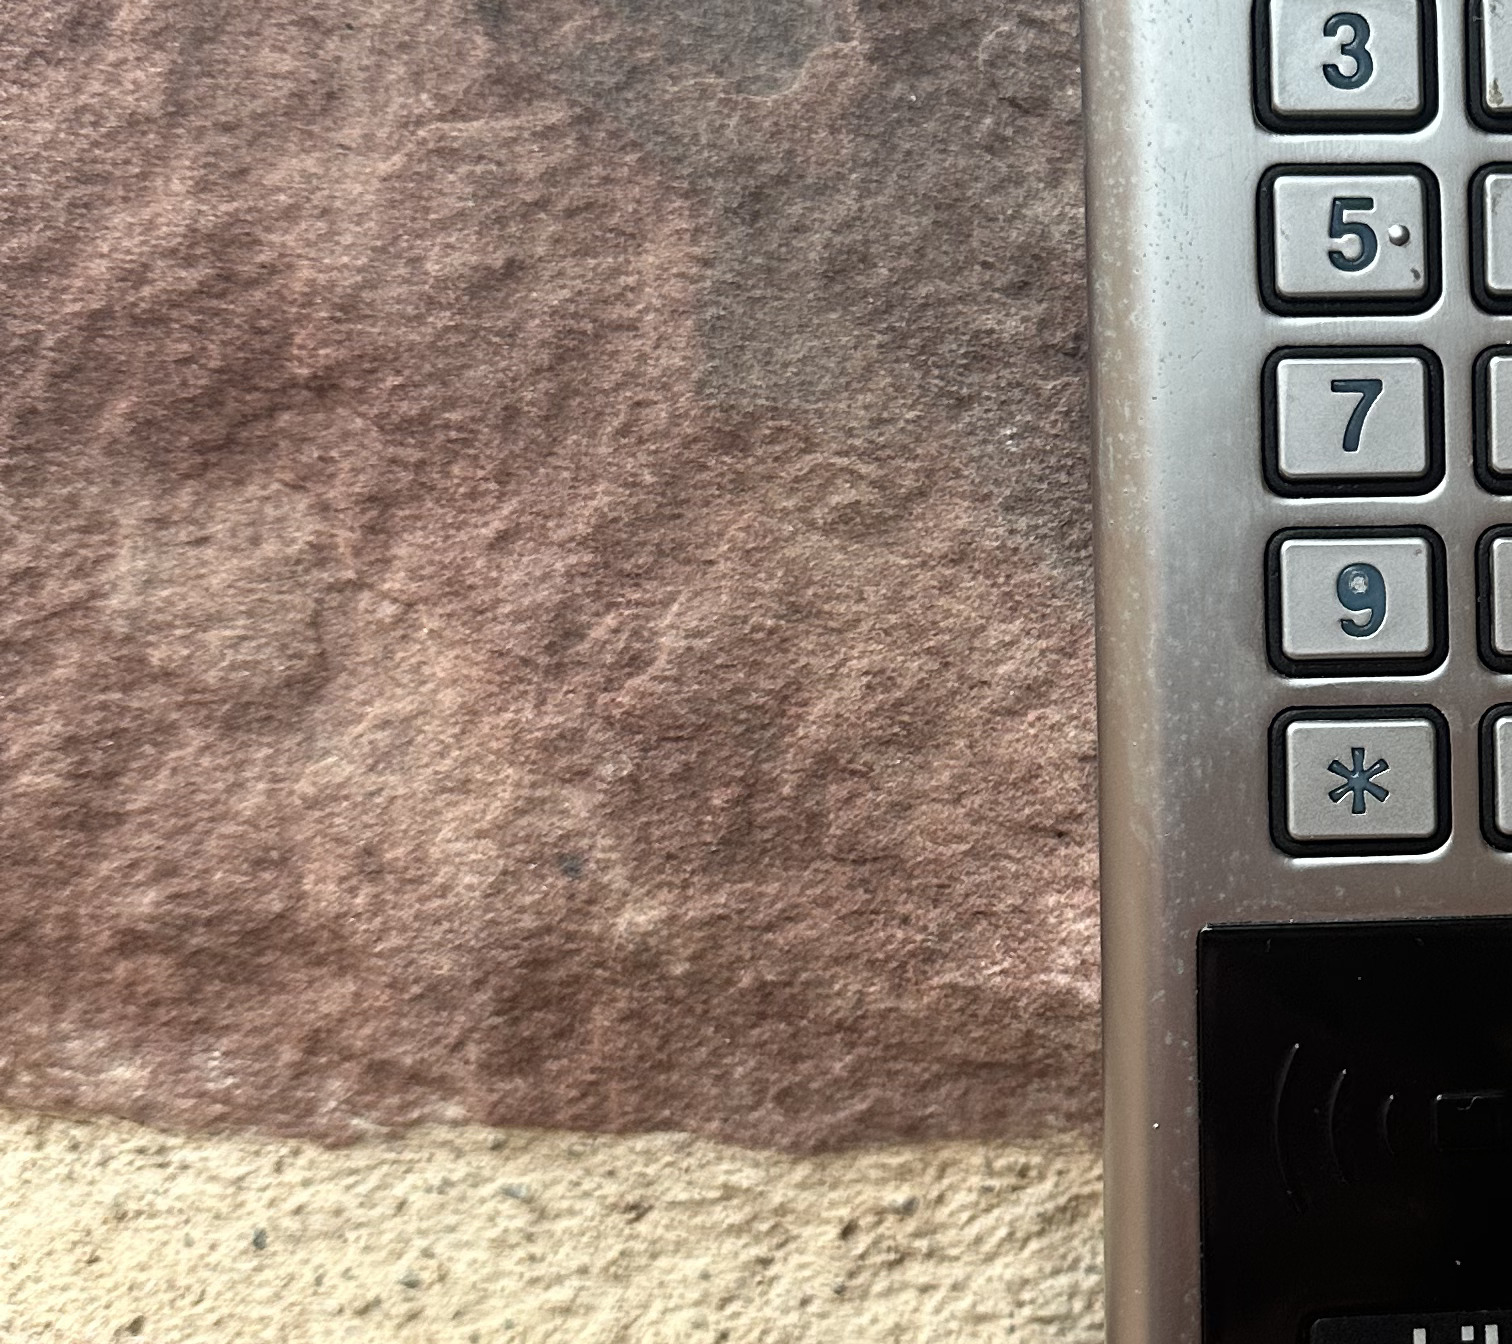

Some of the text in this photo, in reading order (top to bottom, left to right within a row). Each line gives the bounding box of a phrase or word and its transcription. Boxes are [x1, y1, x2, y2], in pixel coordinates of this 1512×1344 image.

[1321, 11, 1375, 92] 3
[1327, 196, 1378, 274] 5
[1329, 378, 1383, 453] 7
[1335, 561, 1388, 637] 9
